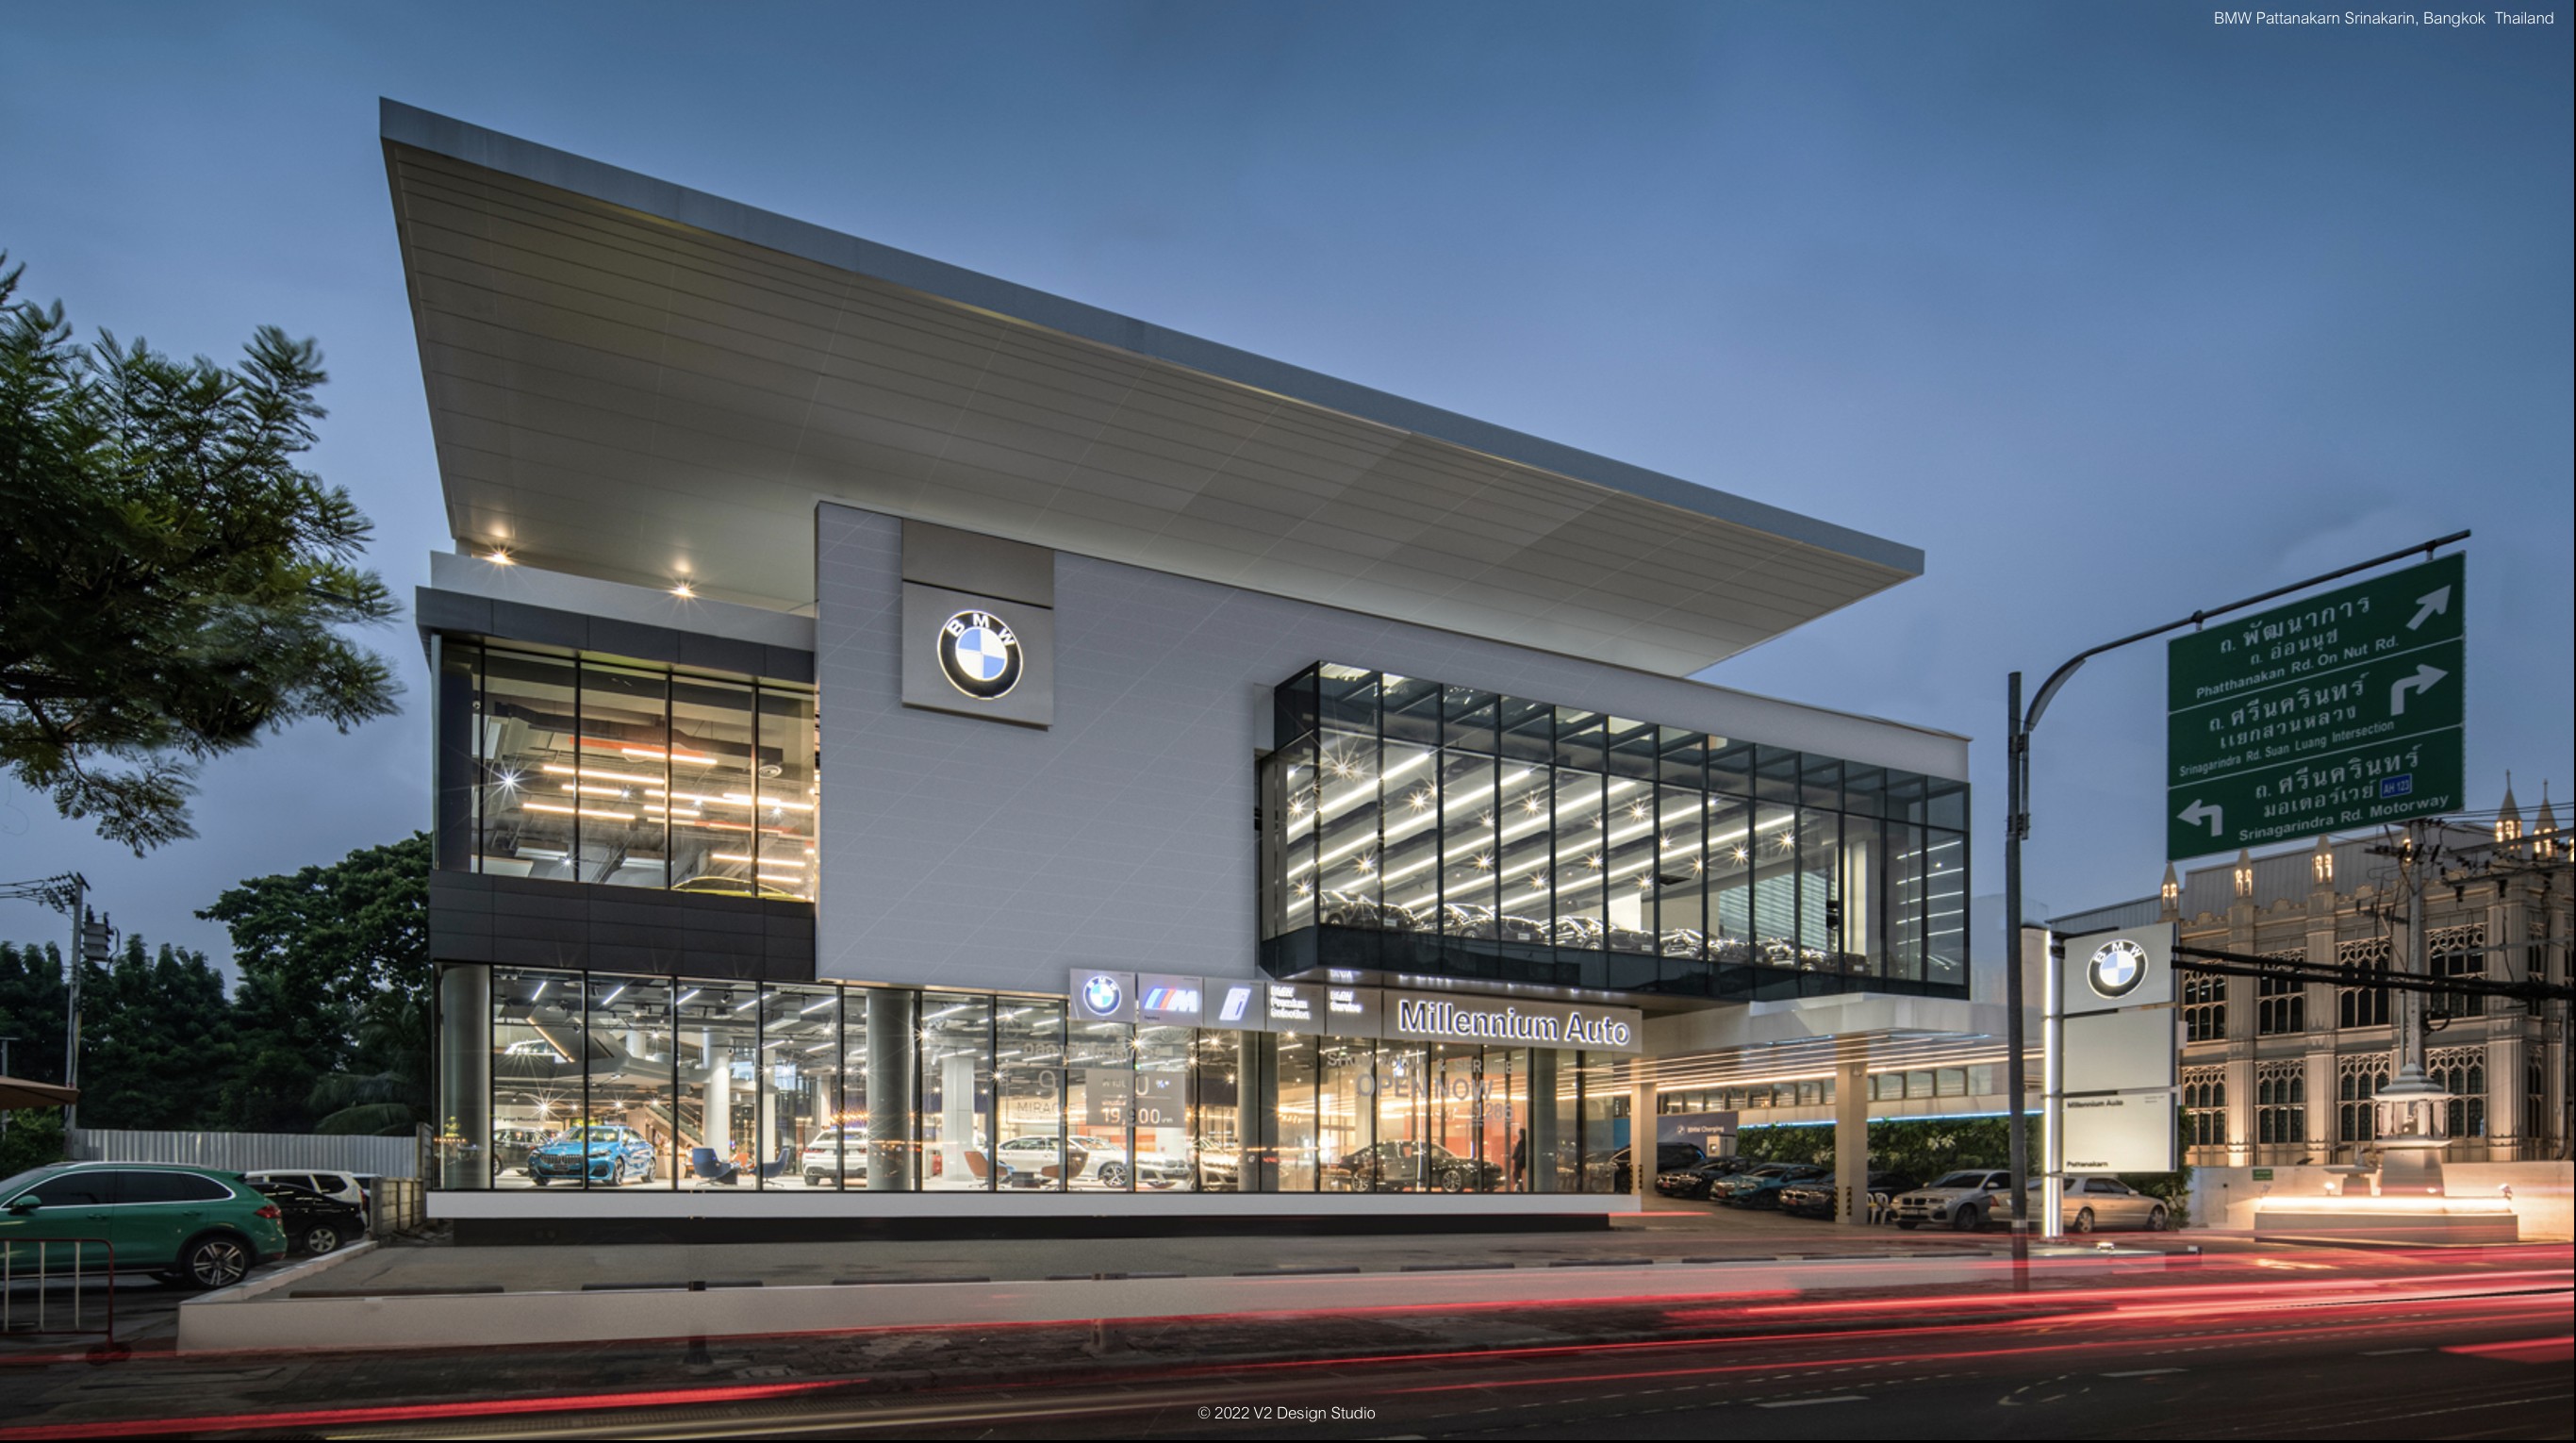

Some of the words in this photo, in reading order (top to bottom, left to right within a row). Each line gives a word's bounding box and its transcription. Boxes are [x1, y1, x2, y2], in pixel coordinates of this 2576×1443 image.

[946, 613, 1016, 646] BMW
[2196, 667, 2285, 698] Phatthanakan
[2291, 659, 2312, 672] Rd.
[2318, 654, 2337, 666] On
[2344, 644, 2367, 659] Nut
[2376, 636, 2398, 651] Rd.
[2180, 755, 2240, 776] Srinagarindra
[2246, 749, 2262, 762] Rd.
[2265, 743, 2290, 758] Suan
[2295, 735, 2327, 753] Luang
[2333, 720, 2395, 743] Intersection
[2383, 783, 2395, 794] AH
[2397, 779, 2410, 791] 123
[2239, 817, 2334, 841] Srinagarindra
[2341, 809, 2362, 822] Rd.
[2370, 795, 2449, 818] Motorway
[2093, 941, 2144, 963] BMW
[1270, 997, 1308, 1009] Premium
[1398, 999, 1559, 1041] Millennium
[1564, 1011, 1630, 1045] Auto
[1357, 1073, 1427, 1099] OPEN
[1434, 1078, 1494, 1102] NOW
